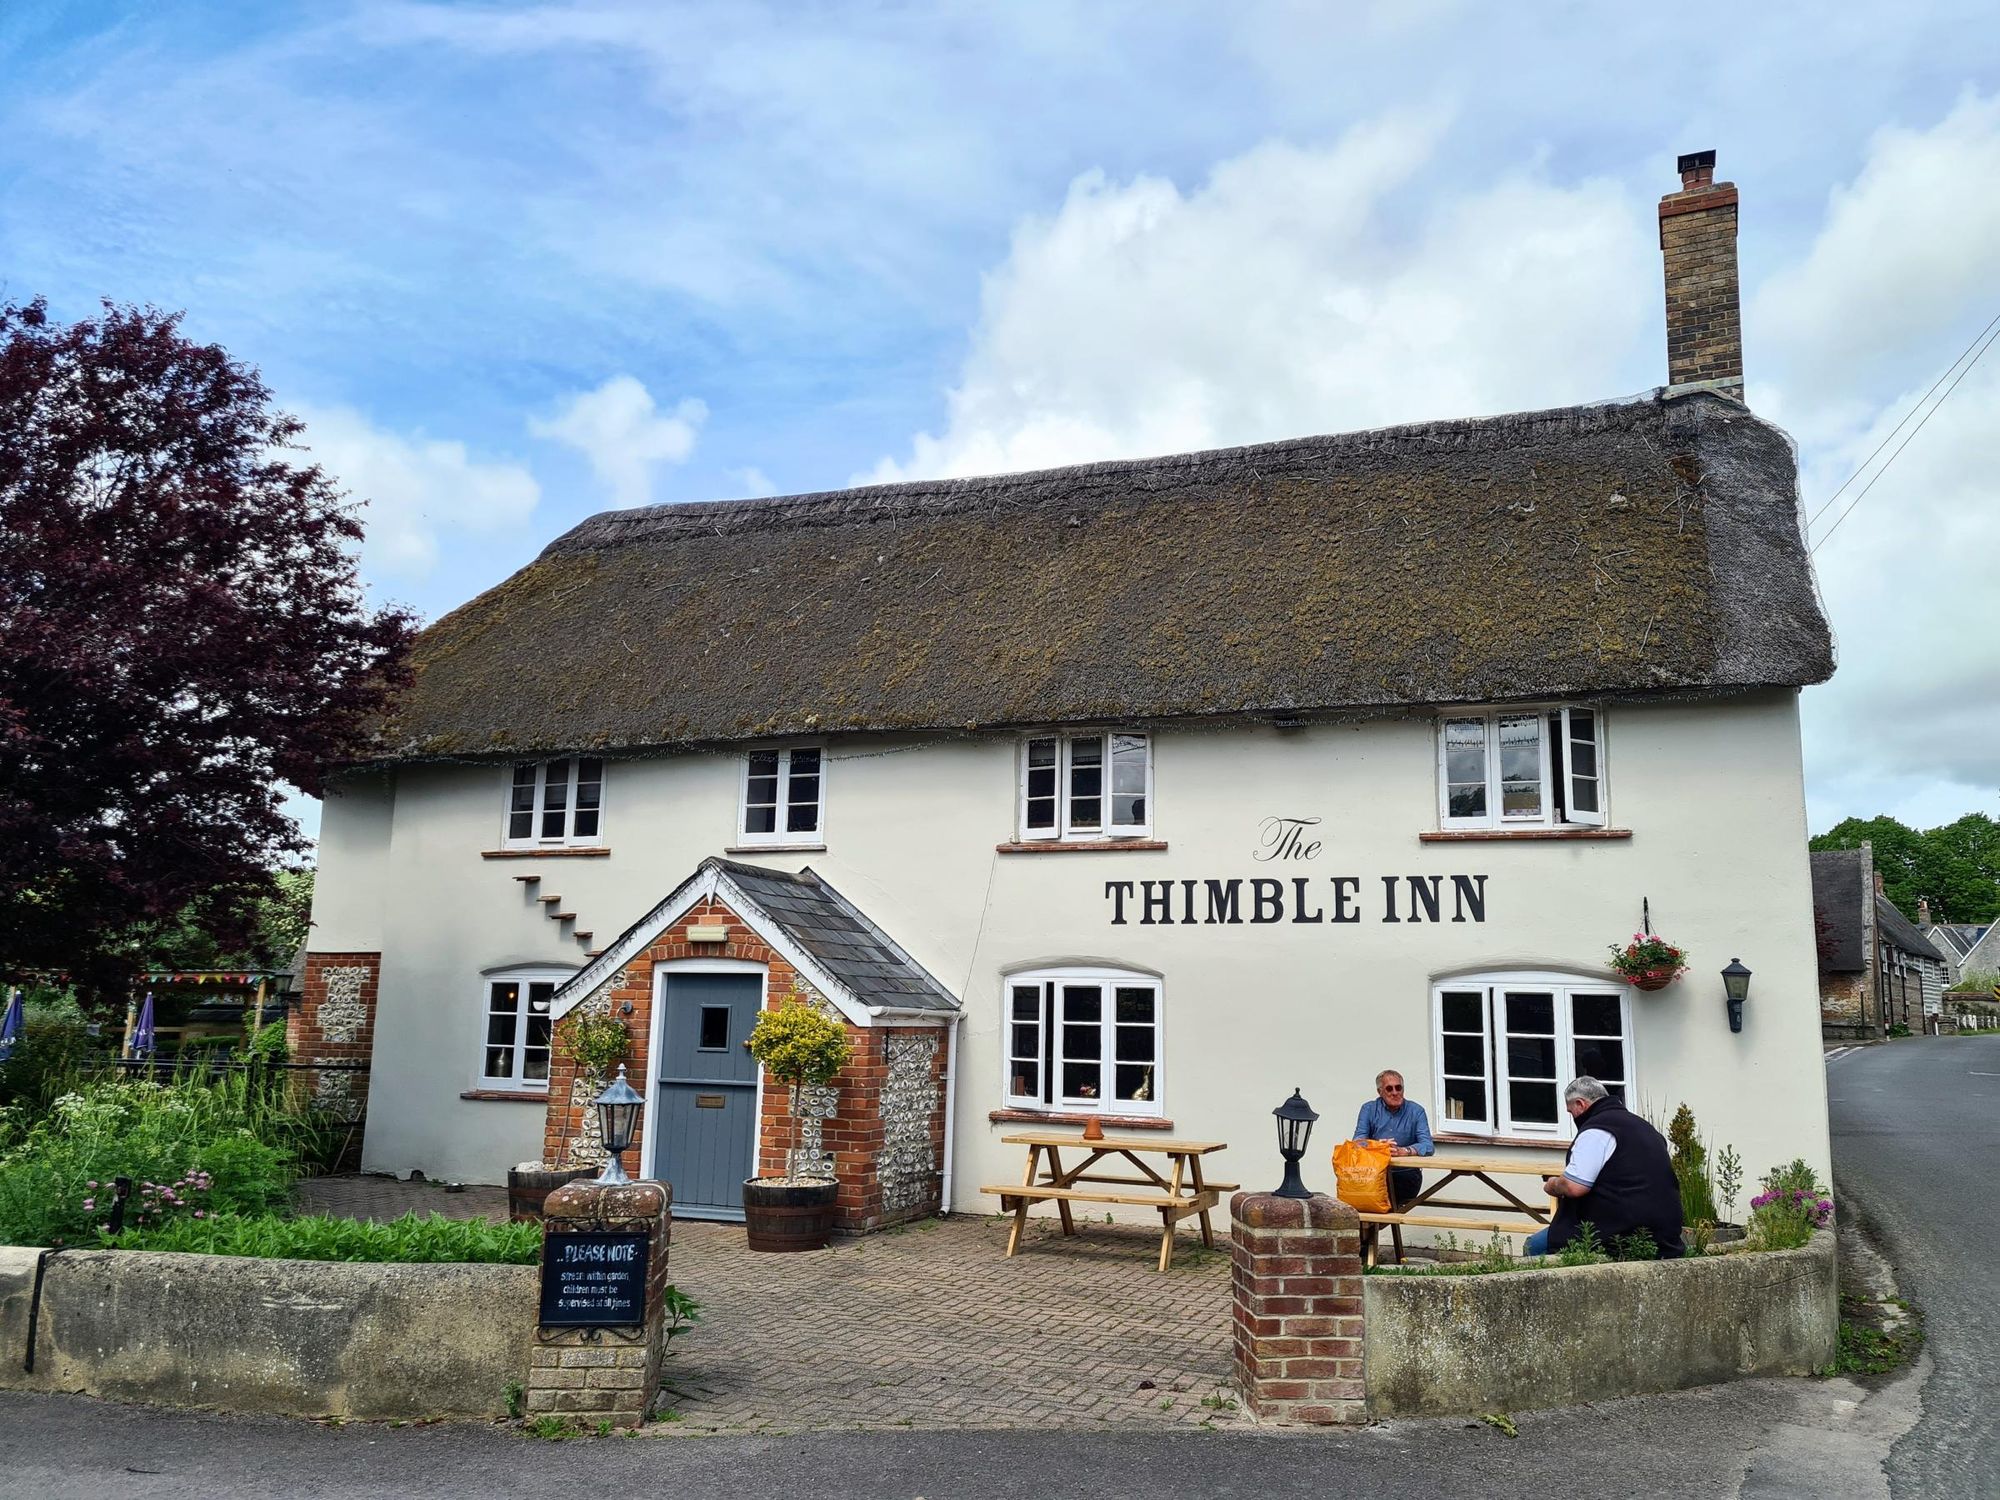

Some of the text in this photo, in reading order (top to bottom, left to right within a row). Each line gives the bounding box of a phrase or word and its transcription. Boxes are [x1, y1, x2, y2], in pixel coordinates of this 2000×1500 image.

[1252, 815, 1323, 862] The
[1105, 874, 1489, 925] THIMBLE INN
[565, 1244, 635, 1262] PLEASE NOTE
[563, 1284, 590, 1294] children
[609, 1284, 618, 1294] be
